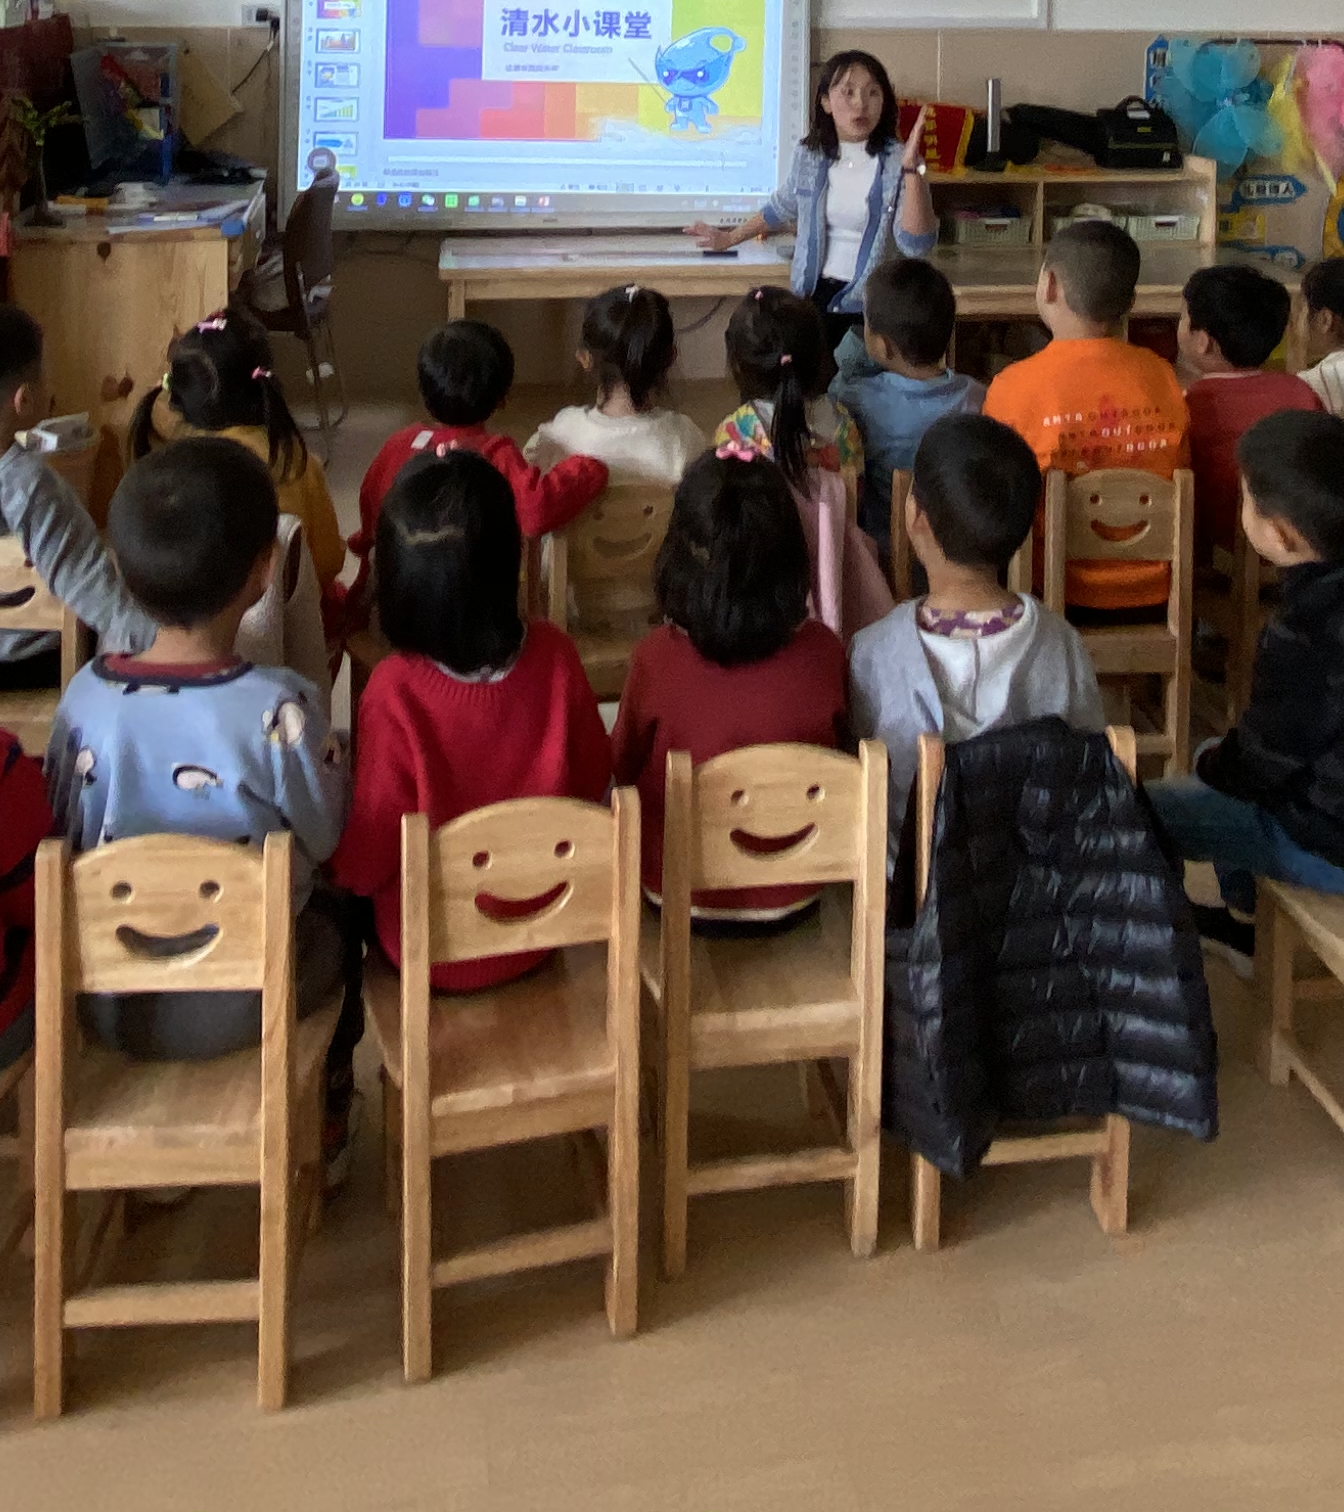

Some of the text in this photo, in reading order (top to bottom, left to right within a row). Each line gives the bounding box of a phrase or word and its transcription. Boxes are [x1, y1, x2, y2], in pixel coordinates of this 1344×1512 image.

[500, 7, 653, 39] 清水小课堂
